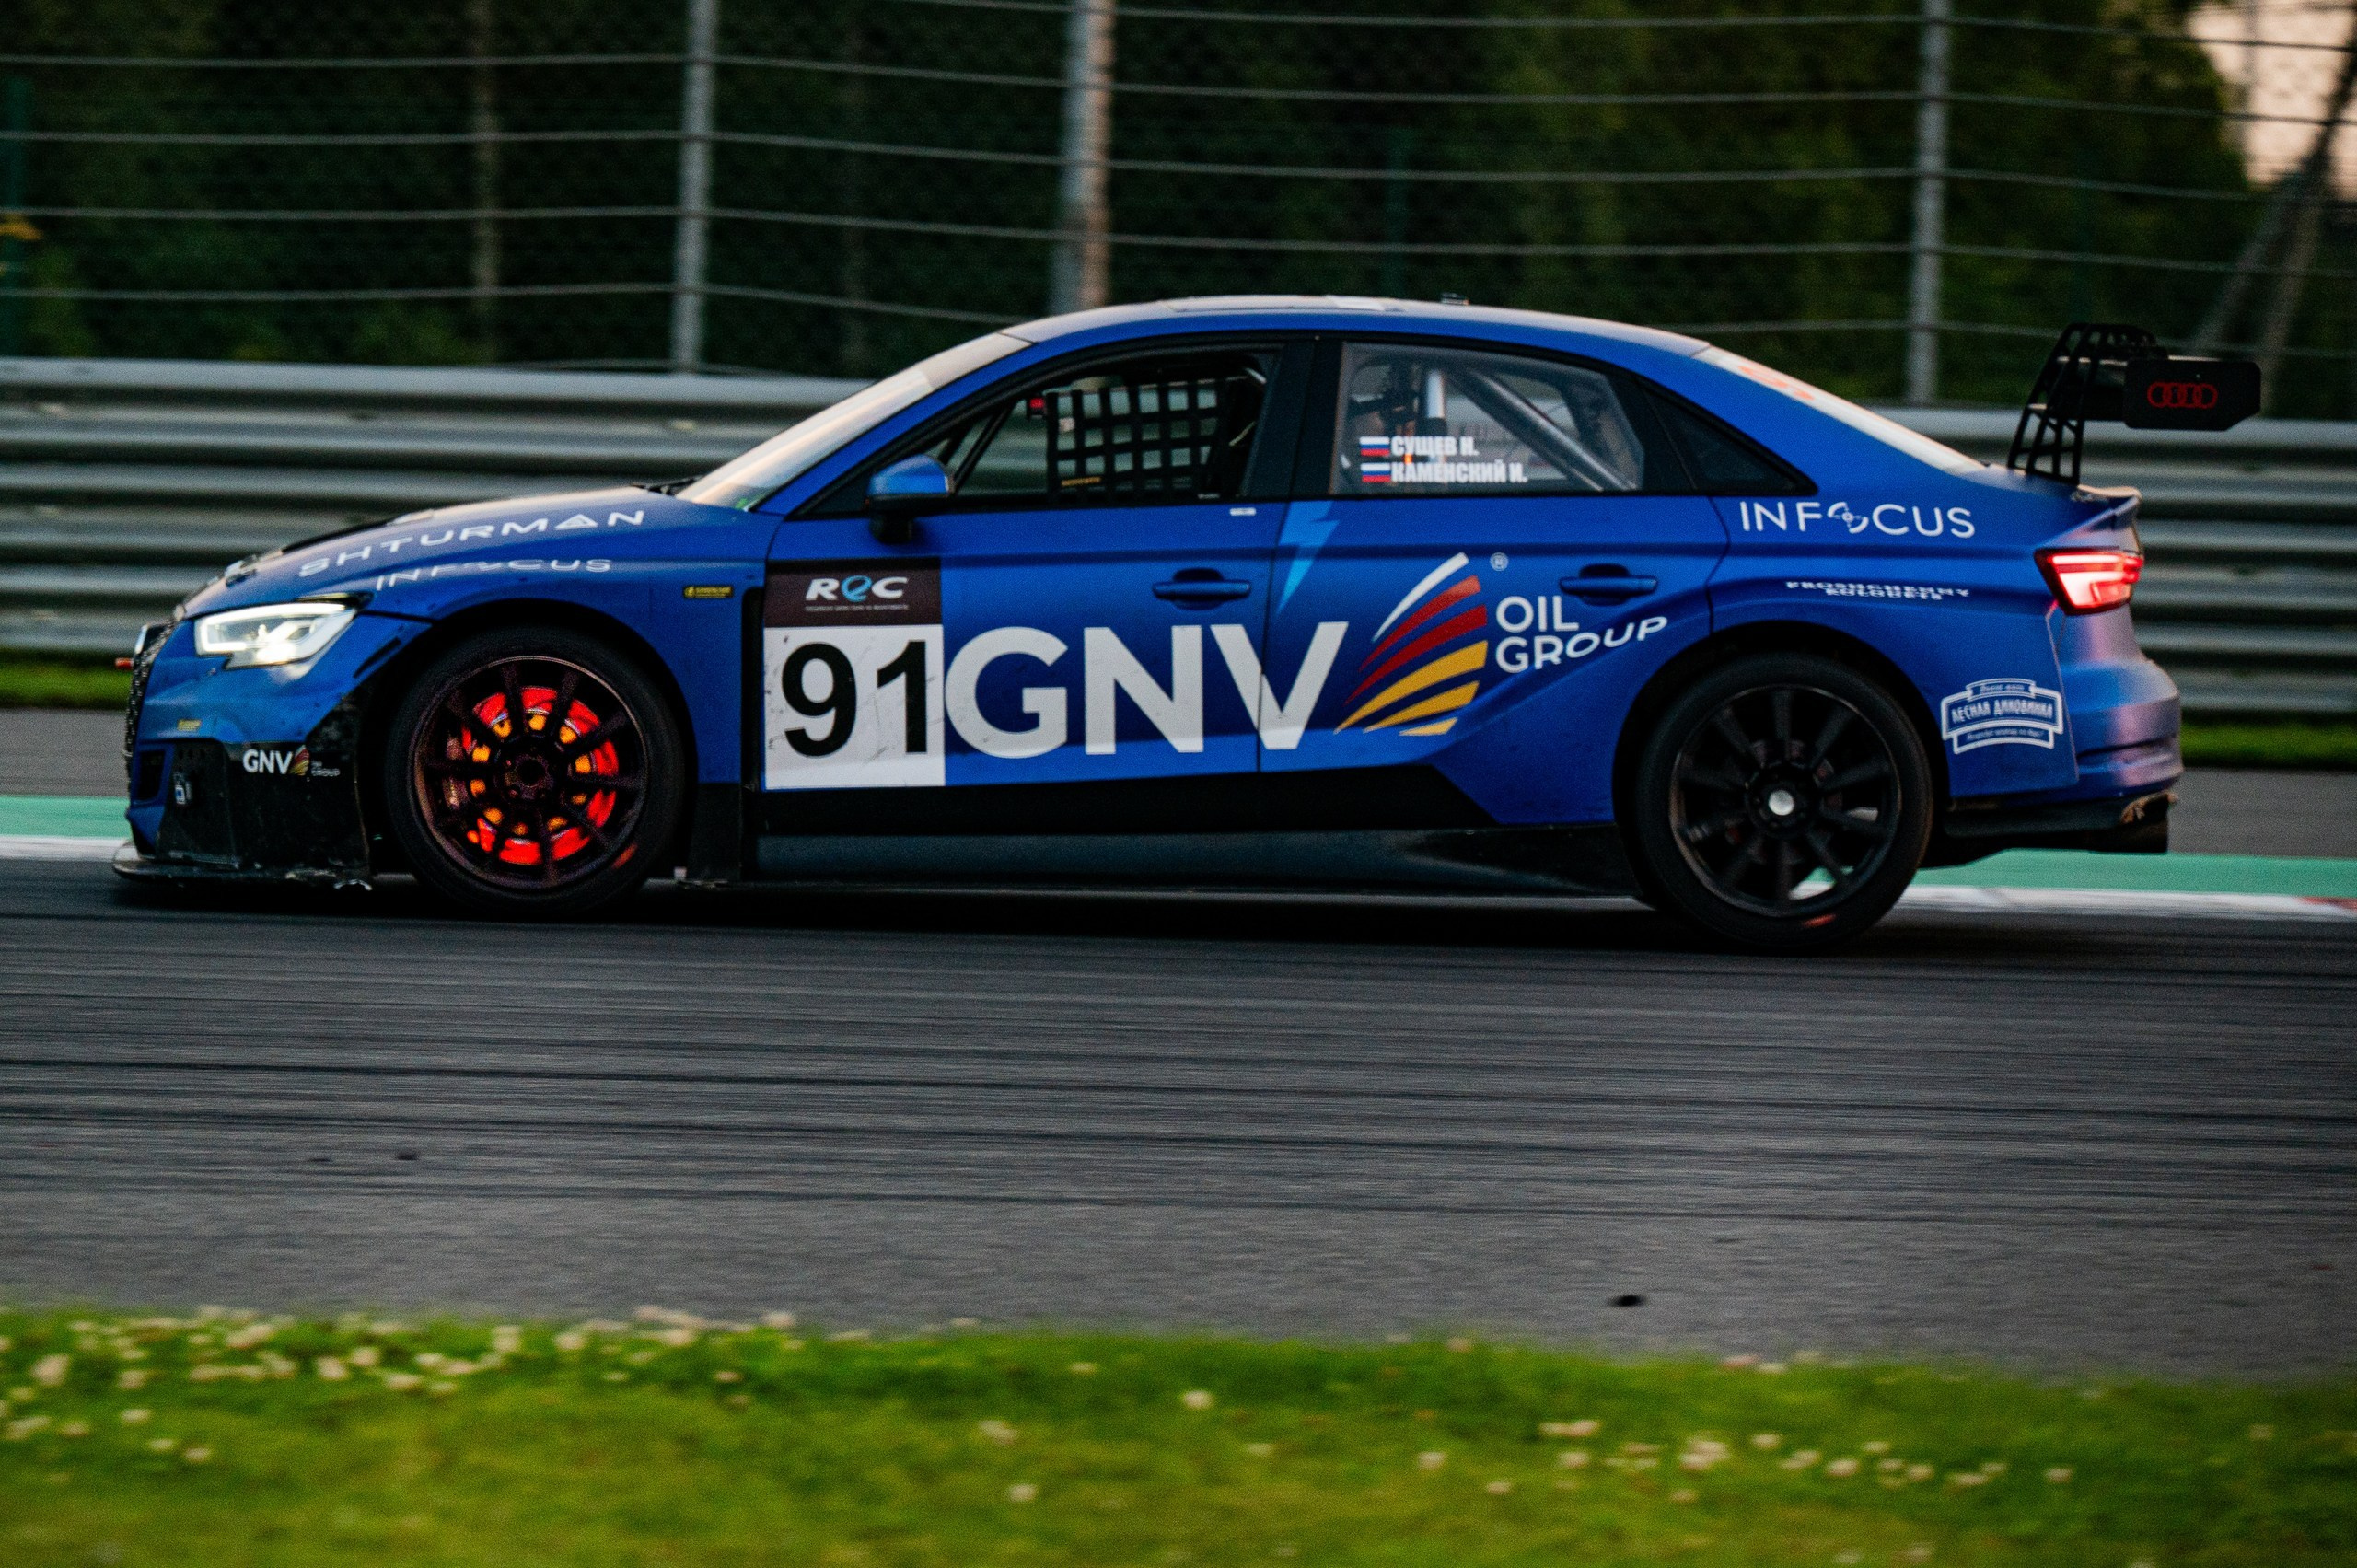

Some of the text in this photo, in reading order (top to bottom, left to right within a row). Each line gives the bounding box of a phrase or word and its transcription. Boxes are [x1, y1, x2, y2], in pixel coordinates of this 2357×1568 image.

[1391, 436, 1457, 458] СУЩЕВ
[1391, 459, 1506, 483] КАМЕНСКИЙ
[1740, 501, 1976, 540] INFOCUS
[299, 509, 644, 577] SHTURMAN
[1495, 595, 1580, 633] OIL
[1495, 616, 1668, 673] GROUP
[781, 639, 927, 758] 91
[945, 621, 1349, 759] GNV
[242, 749, 293, 775] GNV
